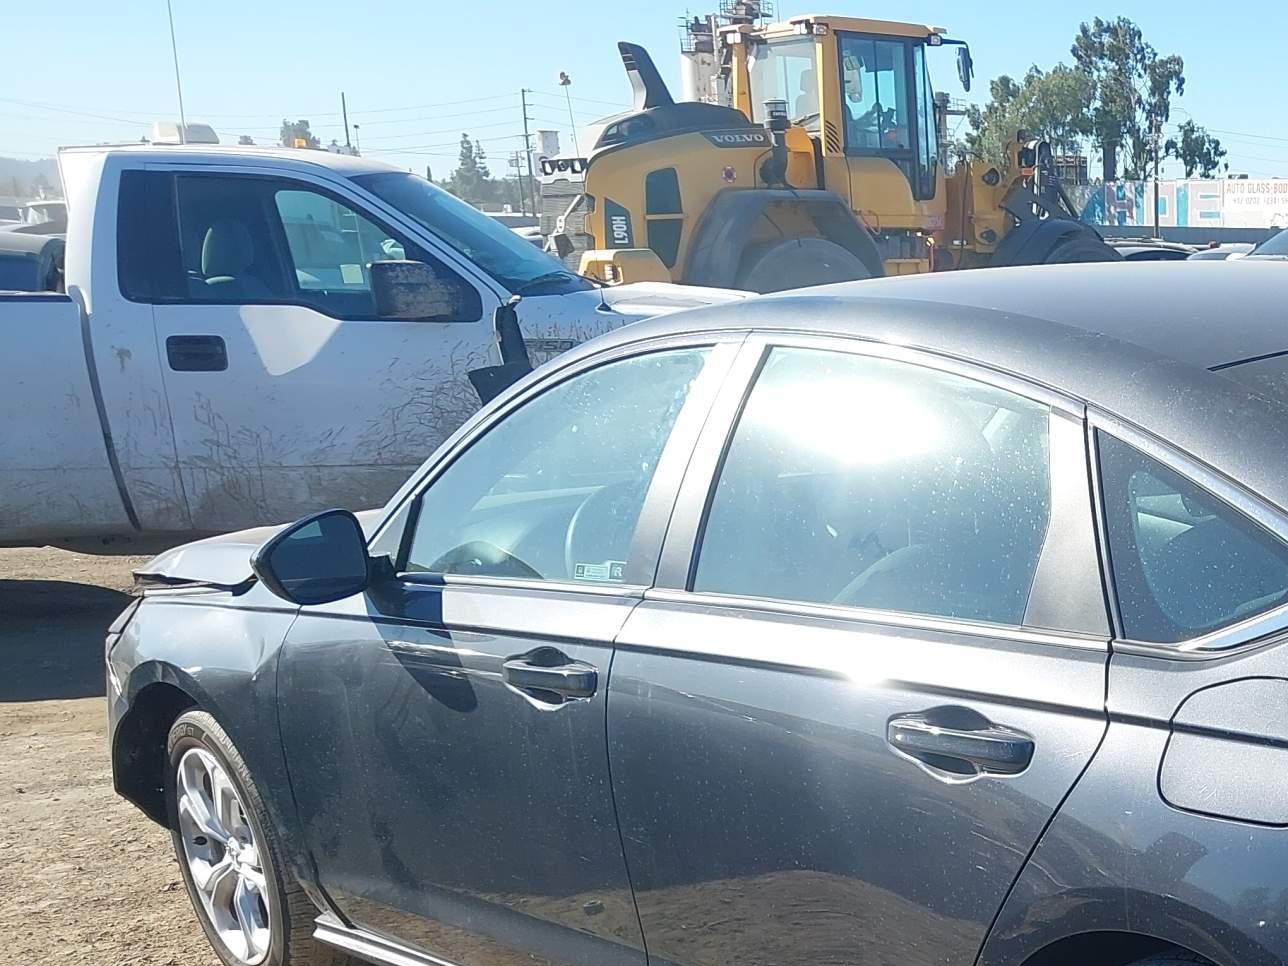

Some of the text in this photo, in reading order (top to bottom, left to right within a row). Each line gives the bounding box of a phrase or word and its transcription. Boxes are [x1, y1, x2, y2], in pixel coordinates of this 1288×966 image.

[711, 134, 764, 143] VOLVO
[1226, 183, 1245, 194] AUTO
[611, 215, 629, 244] L90H
